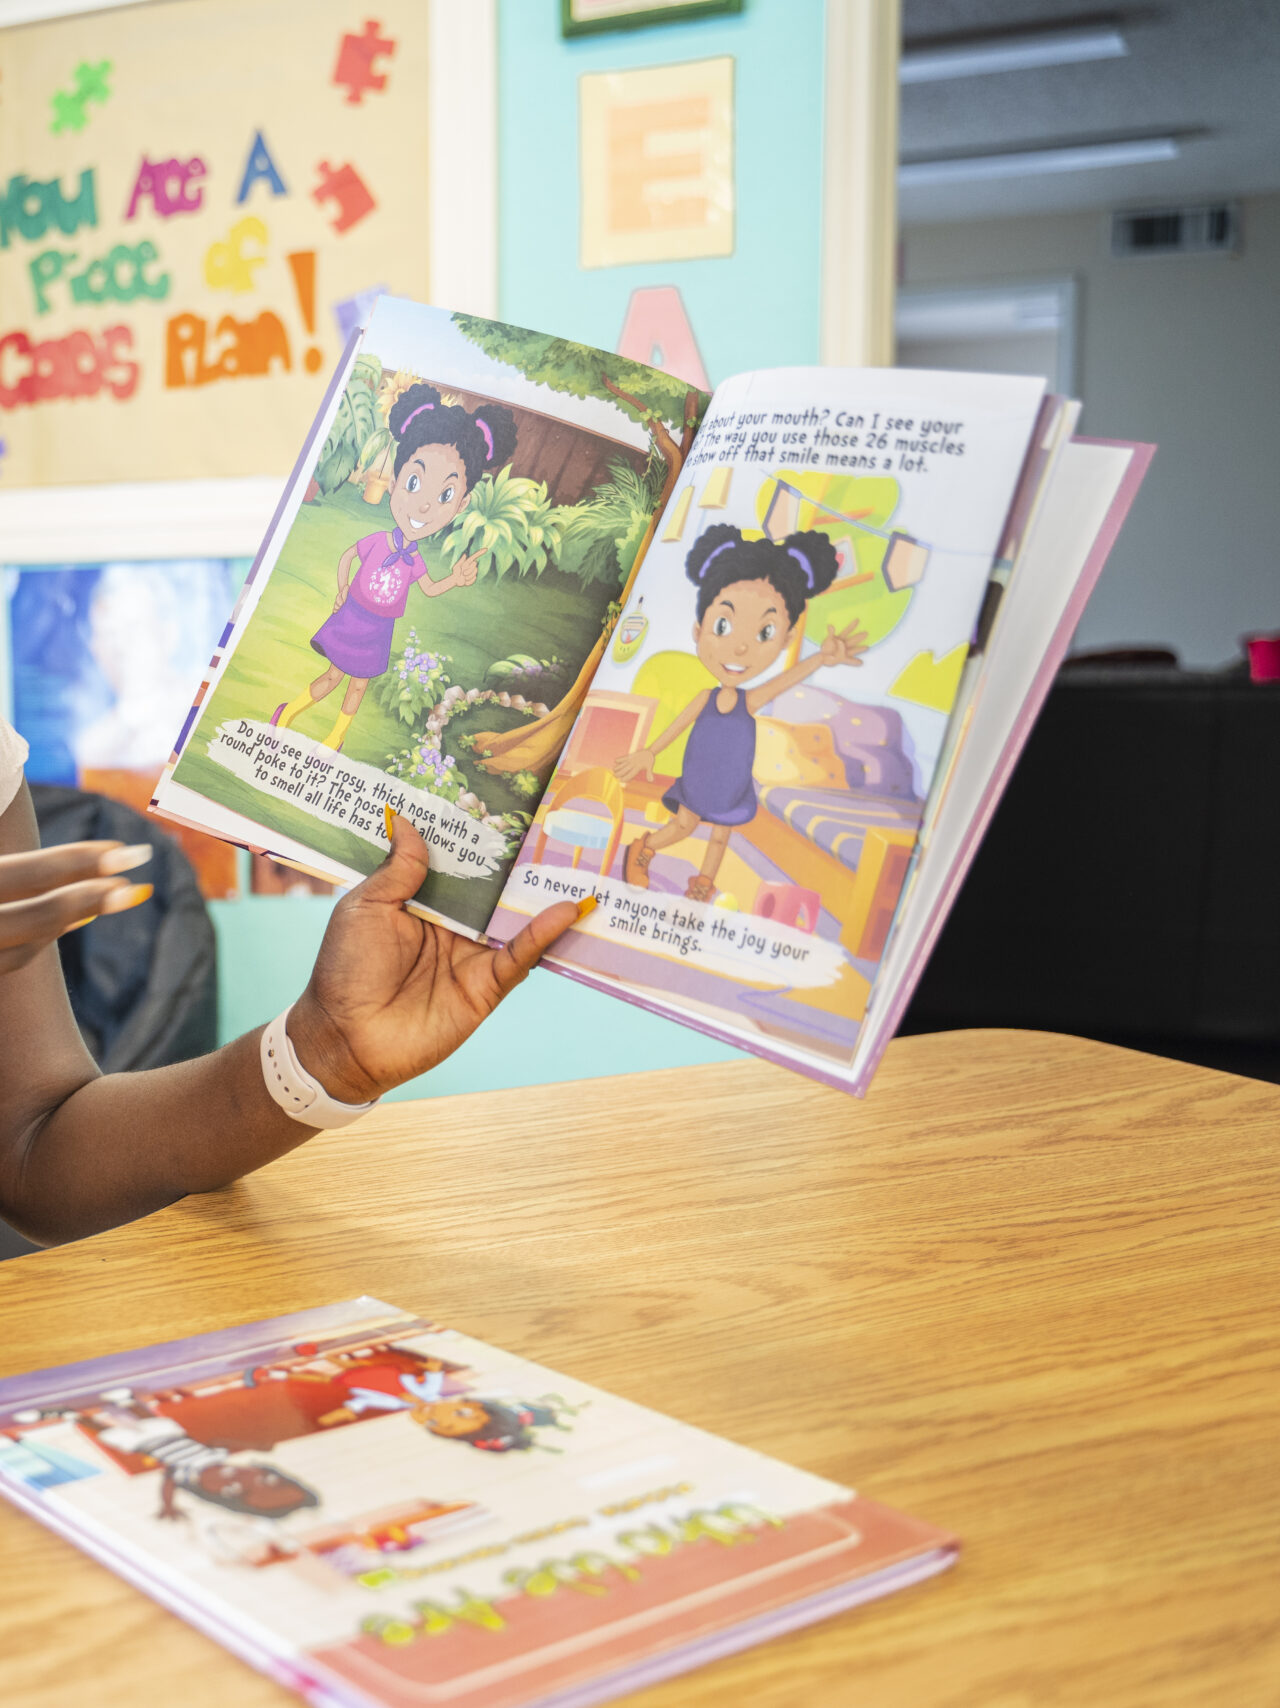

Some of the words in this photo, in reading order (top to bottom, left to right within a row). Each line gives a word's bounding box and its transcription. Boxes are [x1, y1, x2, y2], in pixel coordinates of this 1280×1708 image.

[236, 130, 287, 204] A
[606, 94, 714, 236] E
[692, 447, 716, 467] show
[718, 444, 741, 462] off
[744, 444, 775, 463] that
[779, 446, 820, 465] smile
[825, 451, 877, 470] means
[883, 456, 893, 470] a
[898, 452, 928, 473] lot.
[708, 411, 735, 430] about
[736, 412, 768, 431] your
[771, 406, 831, 427] mouth?
[835, 411, 865, 429] Can
[871, 412, 880, 430] I
[885, 416, 914, 431] see
[919, 419, 964, 438] your
[724, 431, 747, 450] way
[751, 431, 778, 449] you
[782, 431, 808, 445] use
[813, 426, 859, 447] those
[865, 431, 889, 450] 26
[894, 436, 966, 456] muscles
[220, 733, 254, 757] round
[254, 749, 286, 771] poke
[290, 763, 303, 779] to
[306, 769, 327, 787] it?
[328, 781, 352, 803] The
[354, 796, 383, 817] nose
[419, 825, 456, 853] allows
[457, 847, 485, 866] you
[237, 720, 253, 738] Do
[255, 732, 279, 750] you
[281, 744, 301, 760] see
[303, 755, 334, 775] your
[336, 769, 366, 793] rosy,
[373, 782, 406, 809] thick
[408, 803, 436, 823] nose
[440, 818, 468, 840] with
[472, 833, 480, 844] a
[255, 764, 268, 781] to
[270, 775, 304, 798] smell
[305, 790, 322, 807] all
[323, 796, 347, 818] life
[349, 807, 372, 831] has
[375, 823, 388, 839] to
[523, 870, 540, 886] So
[544, 878, 587, 899] never
[591, 886, 610, 906] let
[615, 896, 667, 921] anyone
[672, 910, 705, 932] take
[711, 918, 736, 941] the
[737, 927, 767, 955] joy
[769, 939, 811, 962] your
[609, 914, 648, 936] smile
[651, 921, 703, 956] brings.
